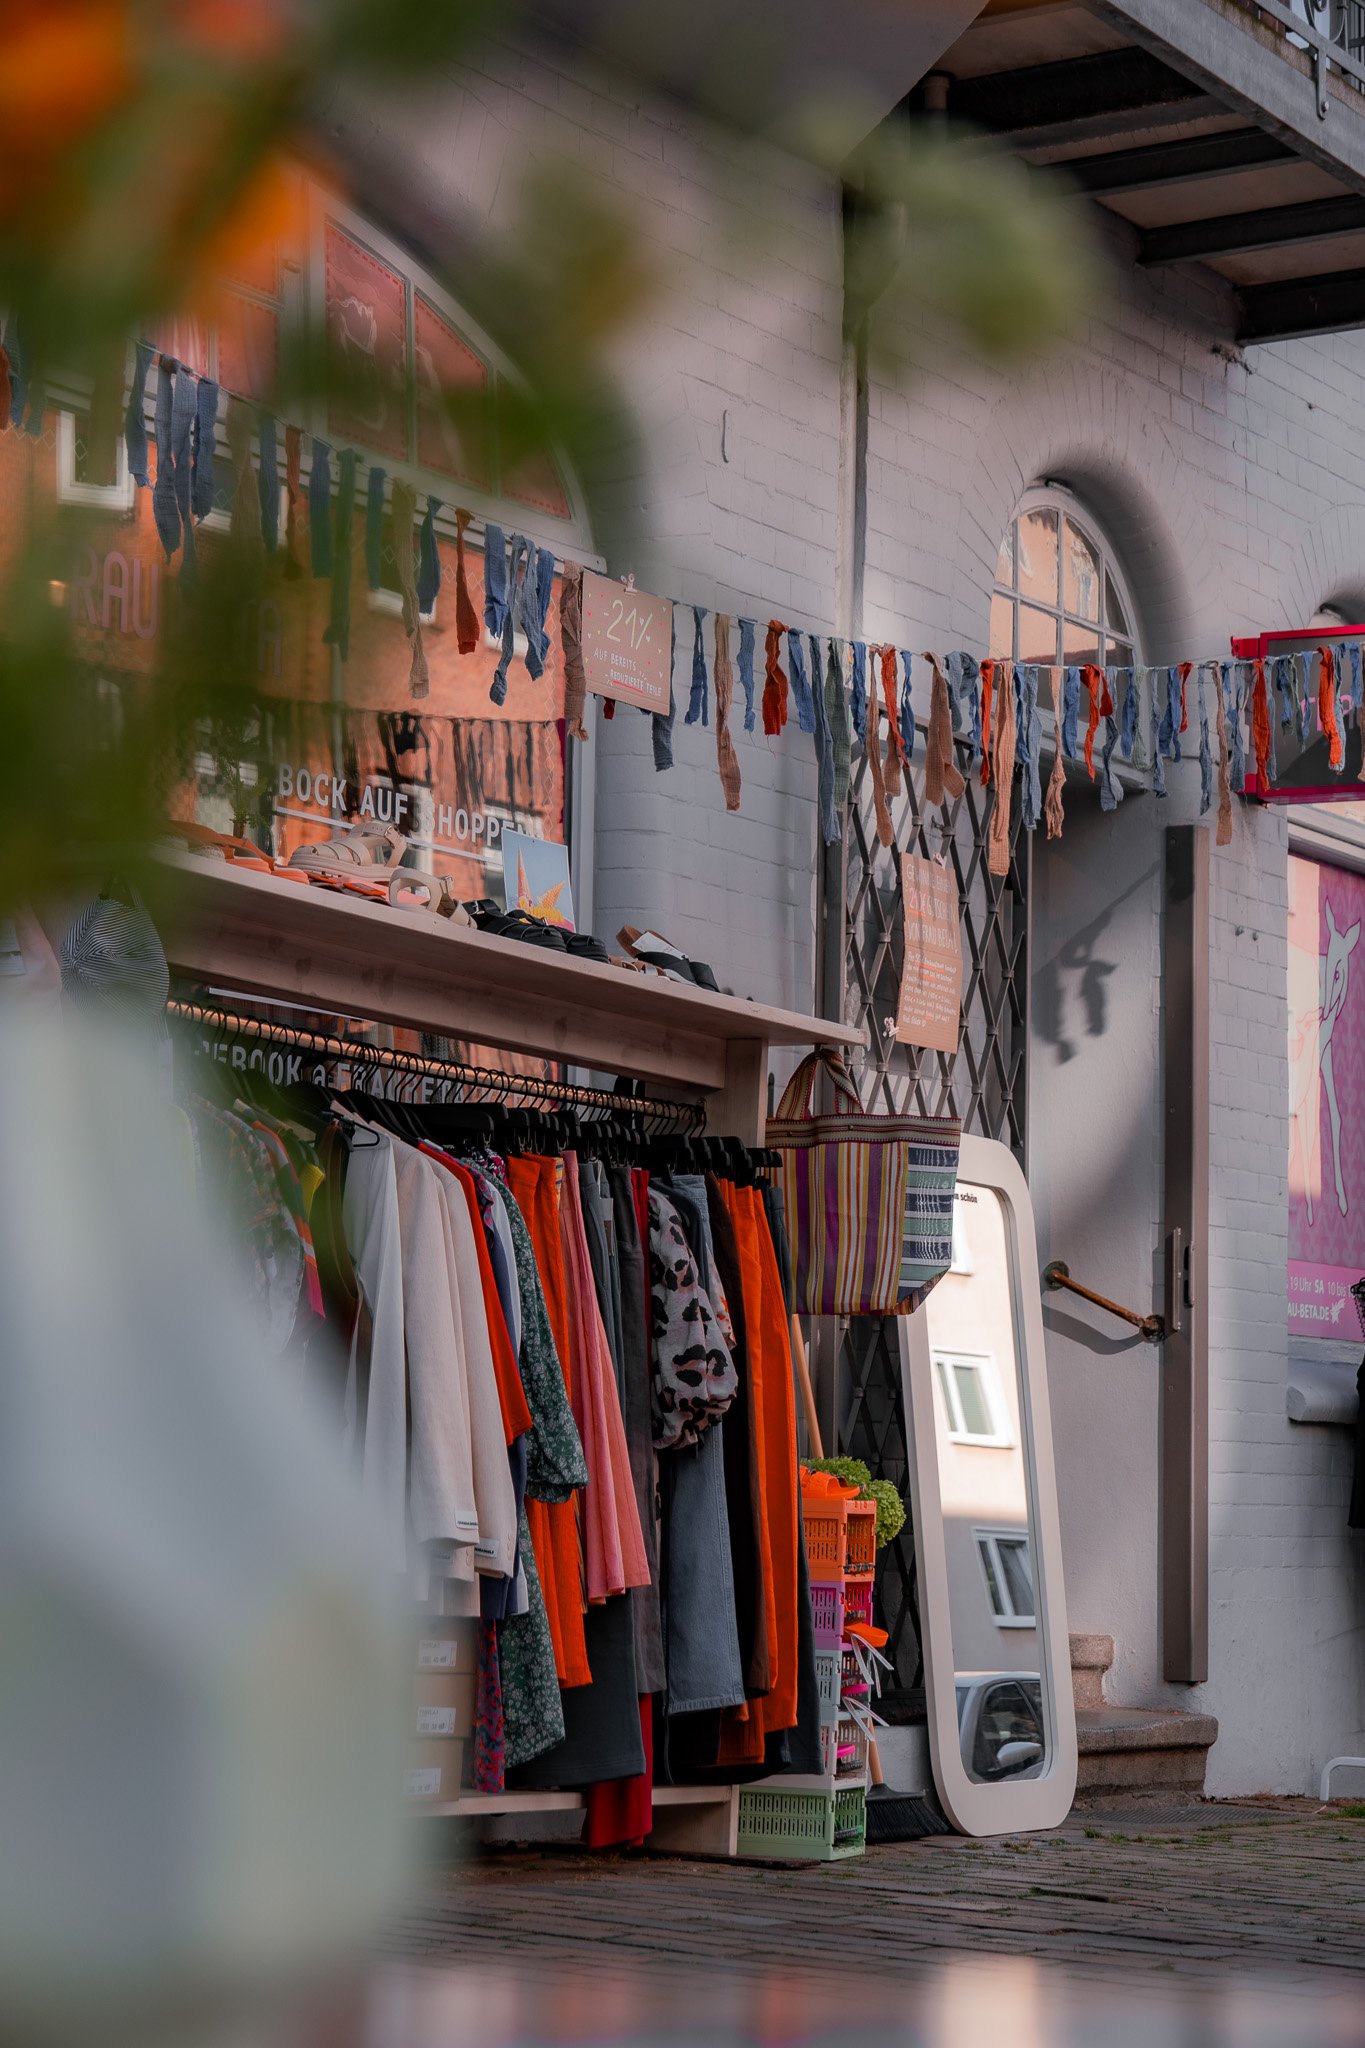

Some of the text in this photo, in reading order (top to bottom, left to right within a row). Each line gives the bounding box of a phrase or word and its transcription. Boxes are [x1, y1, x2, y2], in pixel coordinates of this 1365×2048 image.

[593, 647, 637, 671] AUF BEREITS
[646, 682, 662, 697] TEILE
[278, 763, 348, 811] BOCK
[359, 785, 409, 825] AUF
[193, 1040, 303, 1087] EBOOK
[960, 1193, 978, 1203] schön
[1290, 1276, 1298, 1291] 19
[1299, 1277, 1312, 1293] Uhr
[1314, 1279, 1325, 1294] SA
[1328, 1281, 1336, 1295] 10
[1337, 1282, 1347, 1297] bis
[1287, 1302, 1330, 1320] AU-BETA.DE
